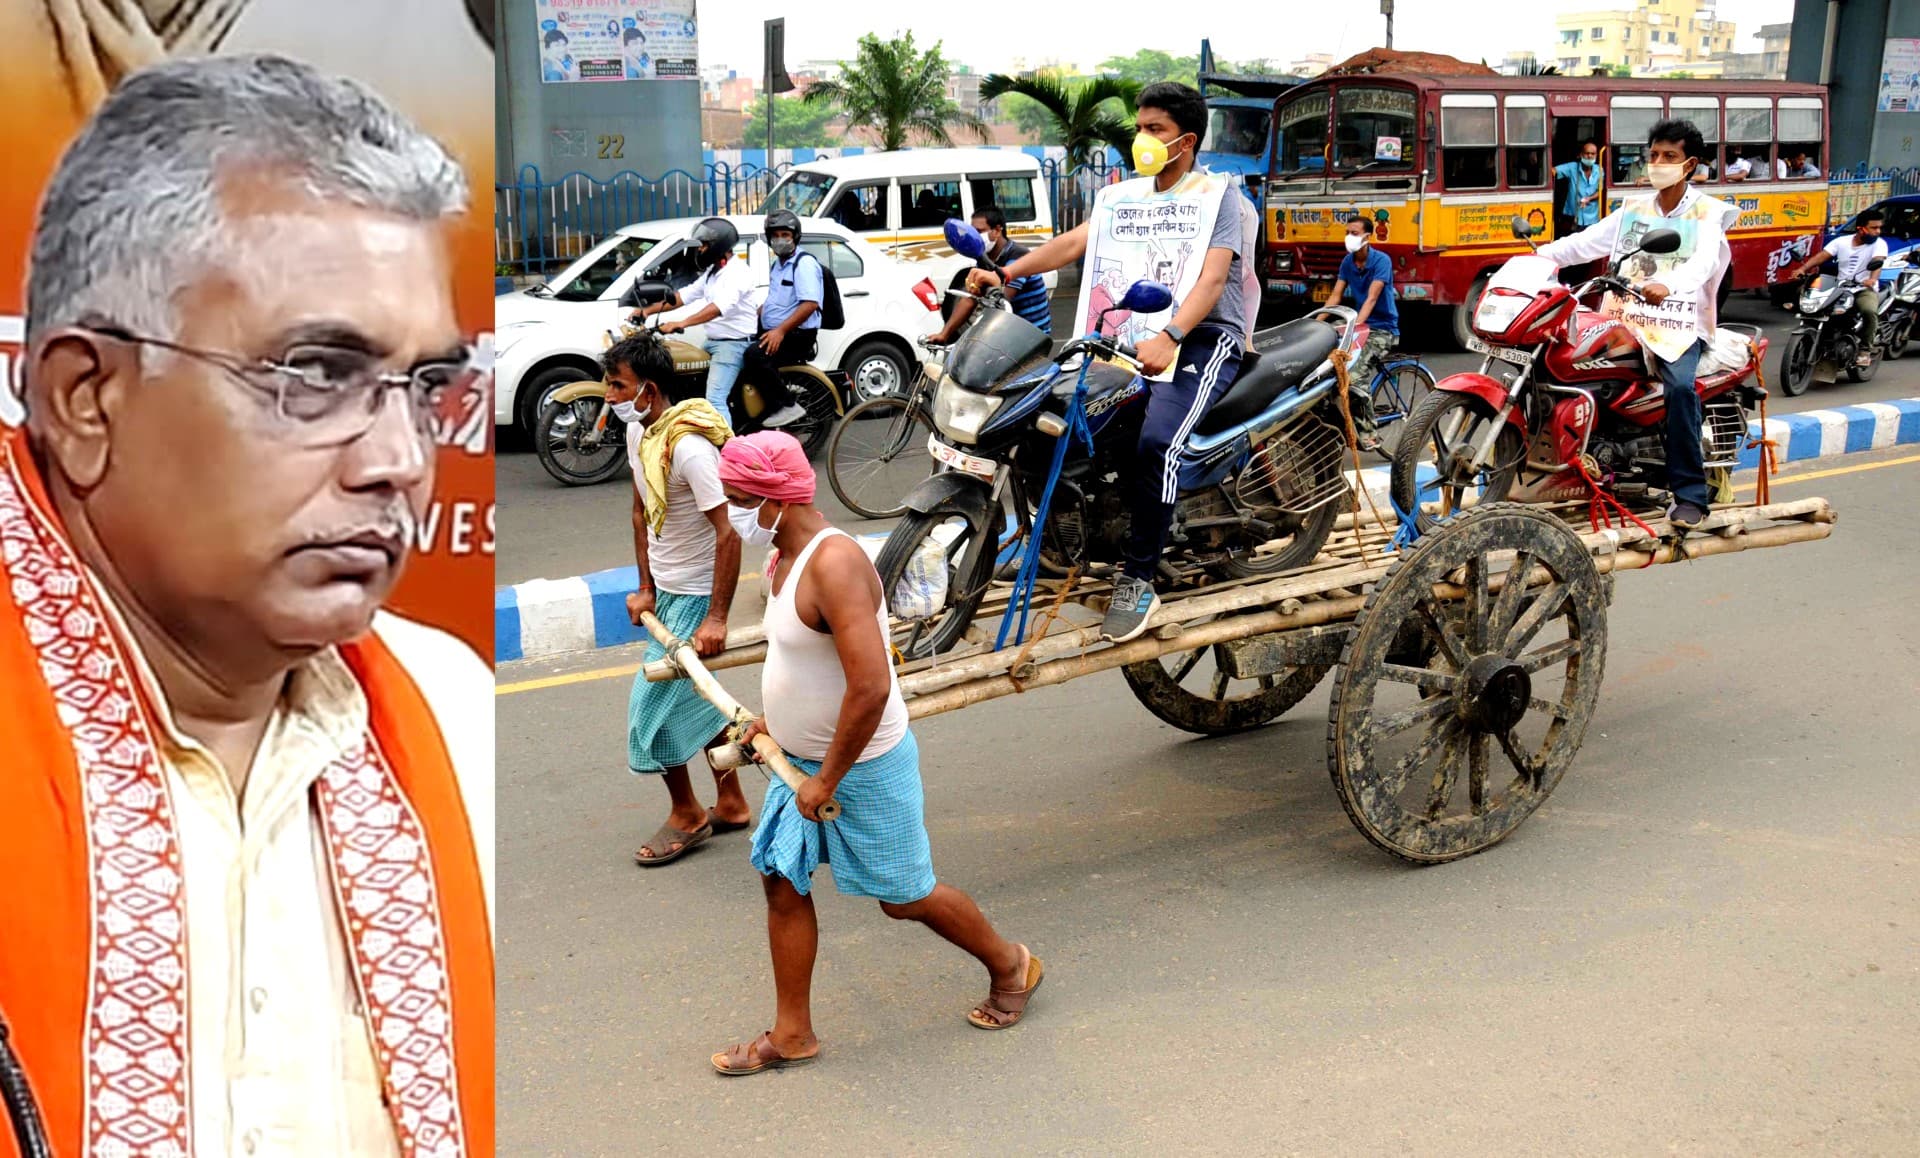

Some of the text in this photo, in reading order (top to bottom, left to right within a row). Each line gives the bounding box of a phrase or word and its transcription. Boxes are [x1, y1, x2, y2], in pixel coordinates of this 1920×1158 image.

[595, 134, 625, 160] 22
[1625, 312, 1657, 328] পেট্রোল
[1659, 318, 1683, 330] লাগে
[1505, 350, 1529, 364] 5309
[1572, 357, 1617, 370] NXG
